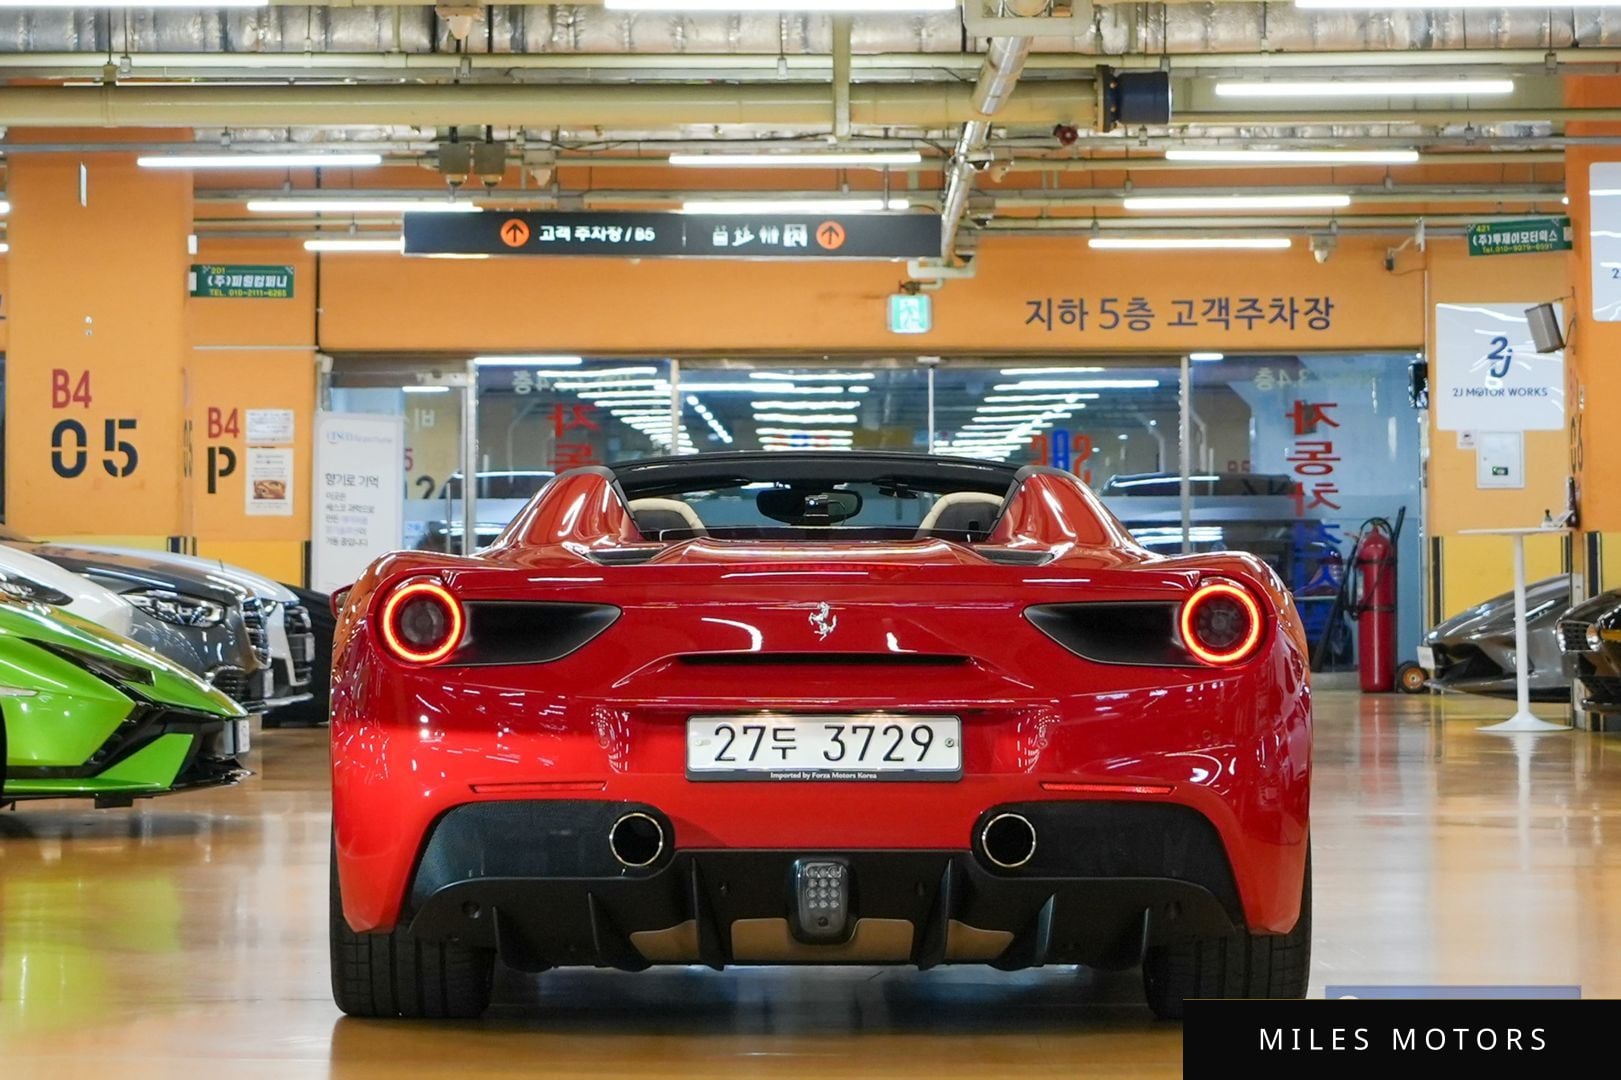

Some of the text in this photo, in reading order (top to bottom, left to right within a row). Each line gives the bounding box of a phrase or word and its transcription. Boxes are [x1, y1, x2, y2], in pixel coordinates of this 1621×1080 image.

[539, 225, 571, 242] 고객
[574, 225, 623, 243] 주차장
[1024, 297, 1335, 332] 지하 5층 고객주차장
[52, 368, 93, 409] B4
[1465, 387, 1505, 397] MOTOR
[1508, 387, 1548, 397] WORKS
[207, 407, 240, 439] B4
[51, 418, 138, 479] 05
[713, 724, 934, 762] 27두 3729
[770, 772, 801, 780] Imported
[802, 772, 810, 780] by
